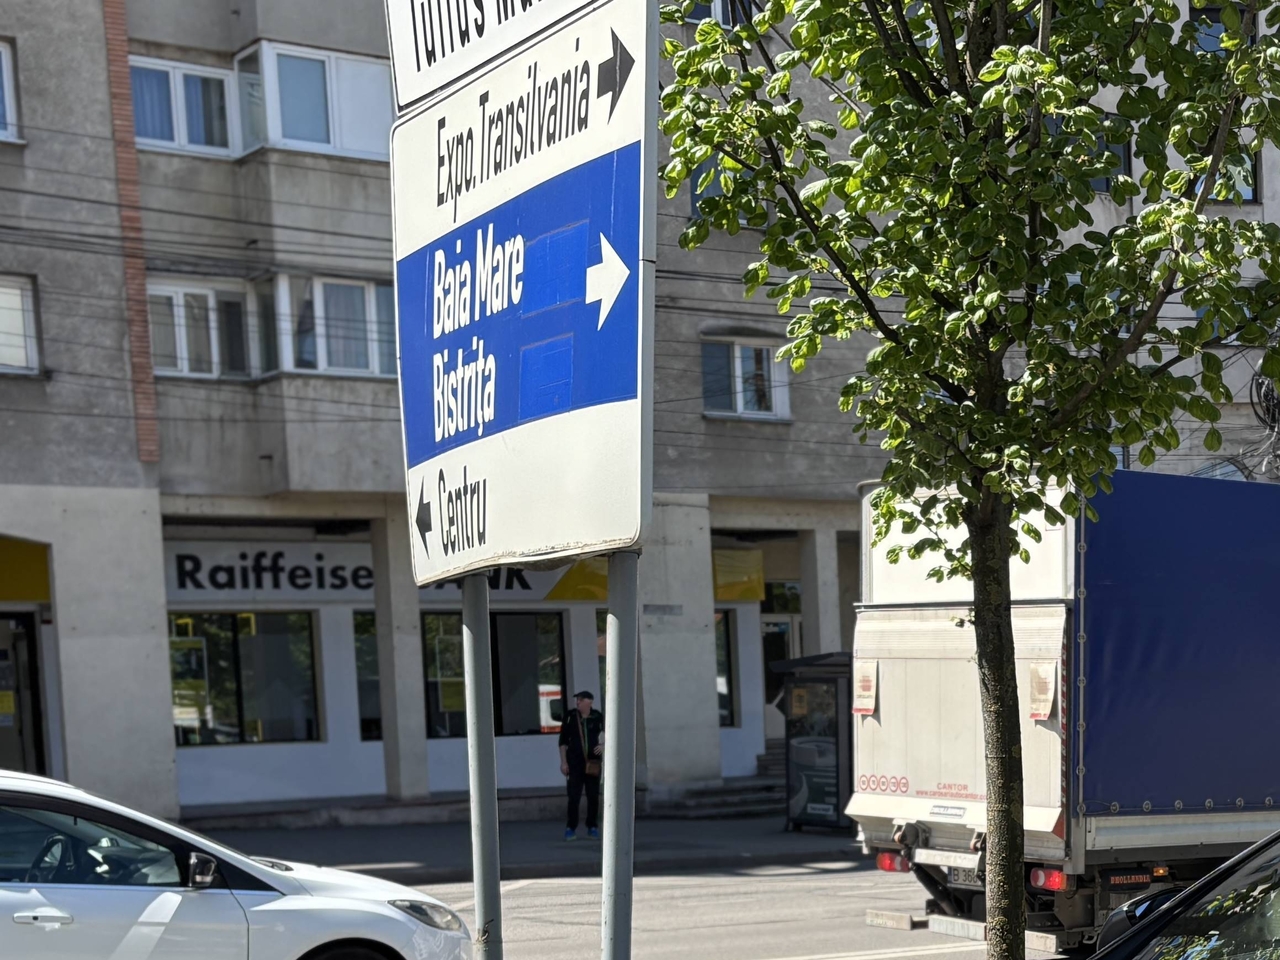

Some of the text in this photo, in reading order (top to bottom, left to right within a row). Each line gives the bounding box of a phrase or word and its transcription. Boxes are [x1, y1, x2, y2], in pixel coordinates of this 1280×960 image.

[479, 37, 590, 185] Transilvania
[432, 223, 524, 339] Baia Mare
[438, 465, 488, 558] Centru
[175, 552, 374, 590] Raiffeise
[937, 783, 968, 791] CANTOR
[953, 868, 959, 881] B
